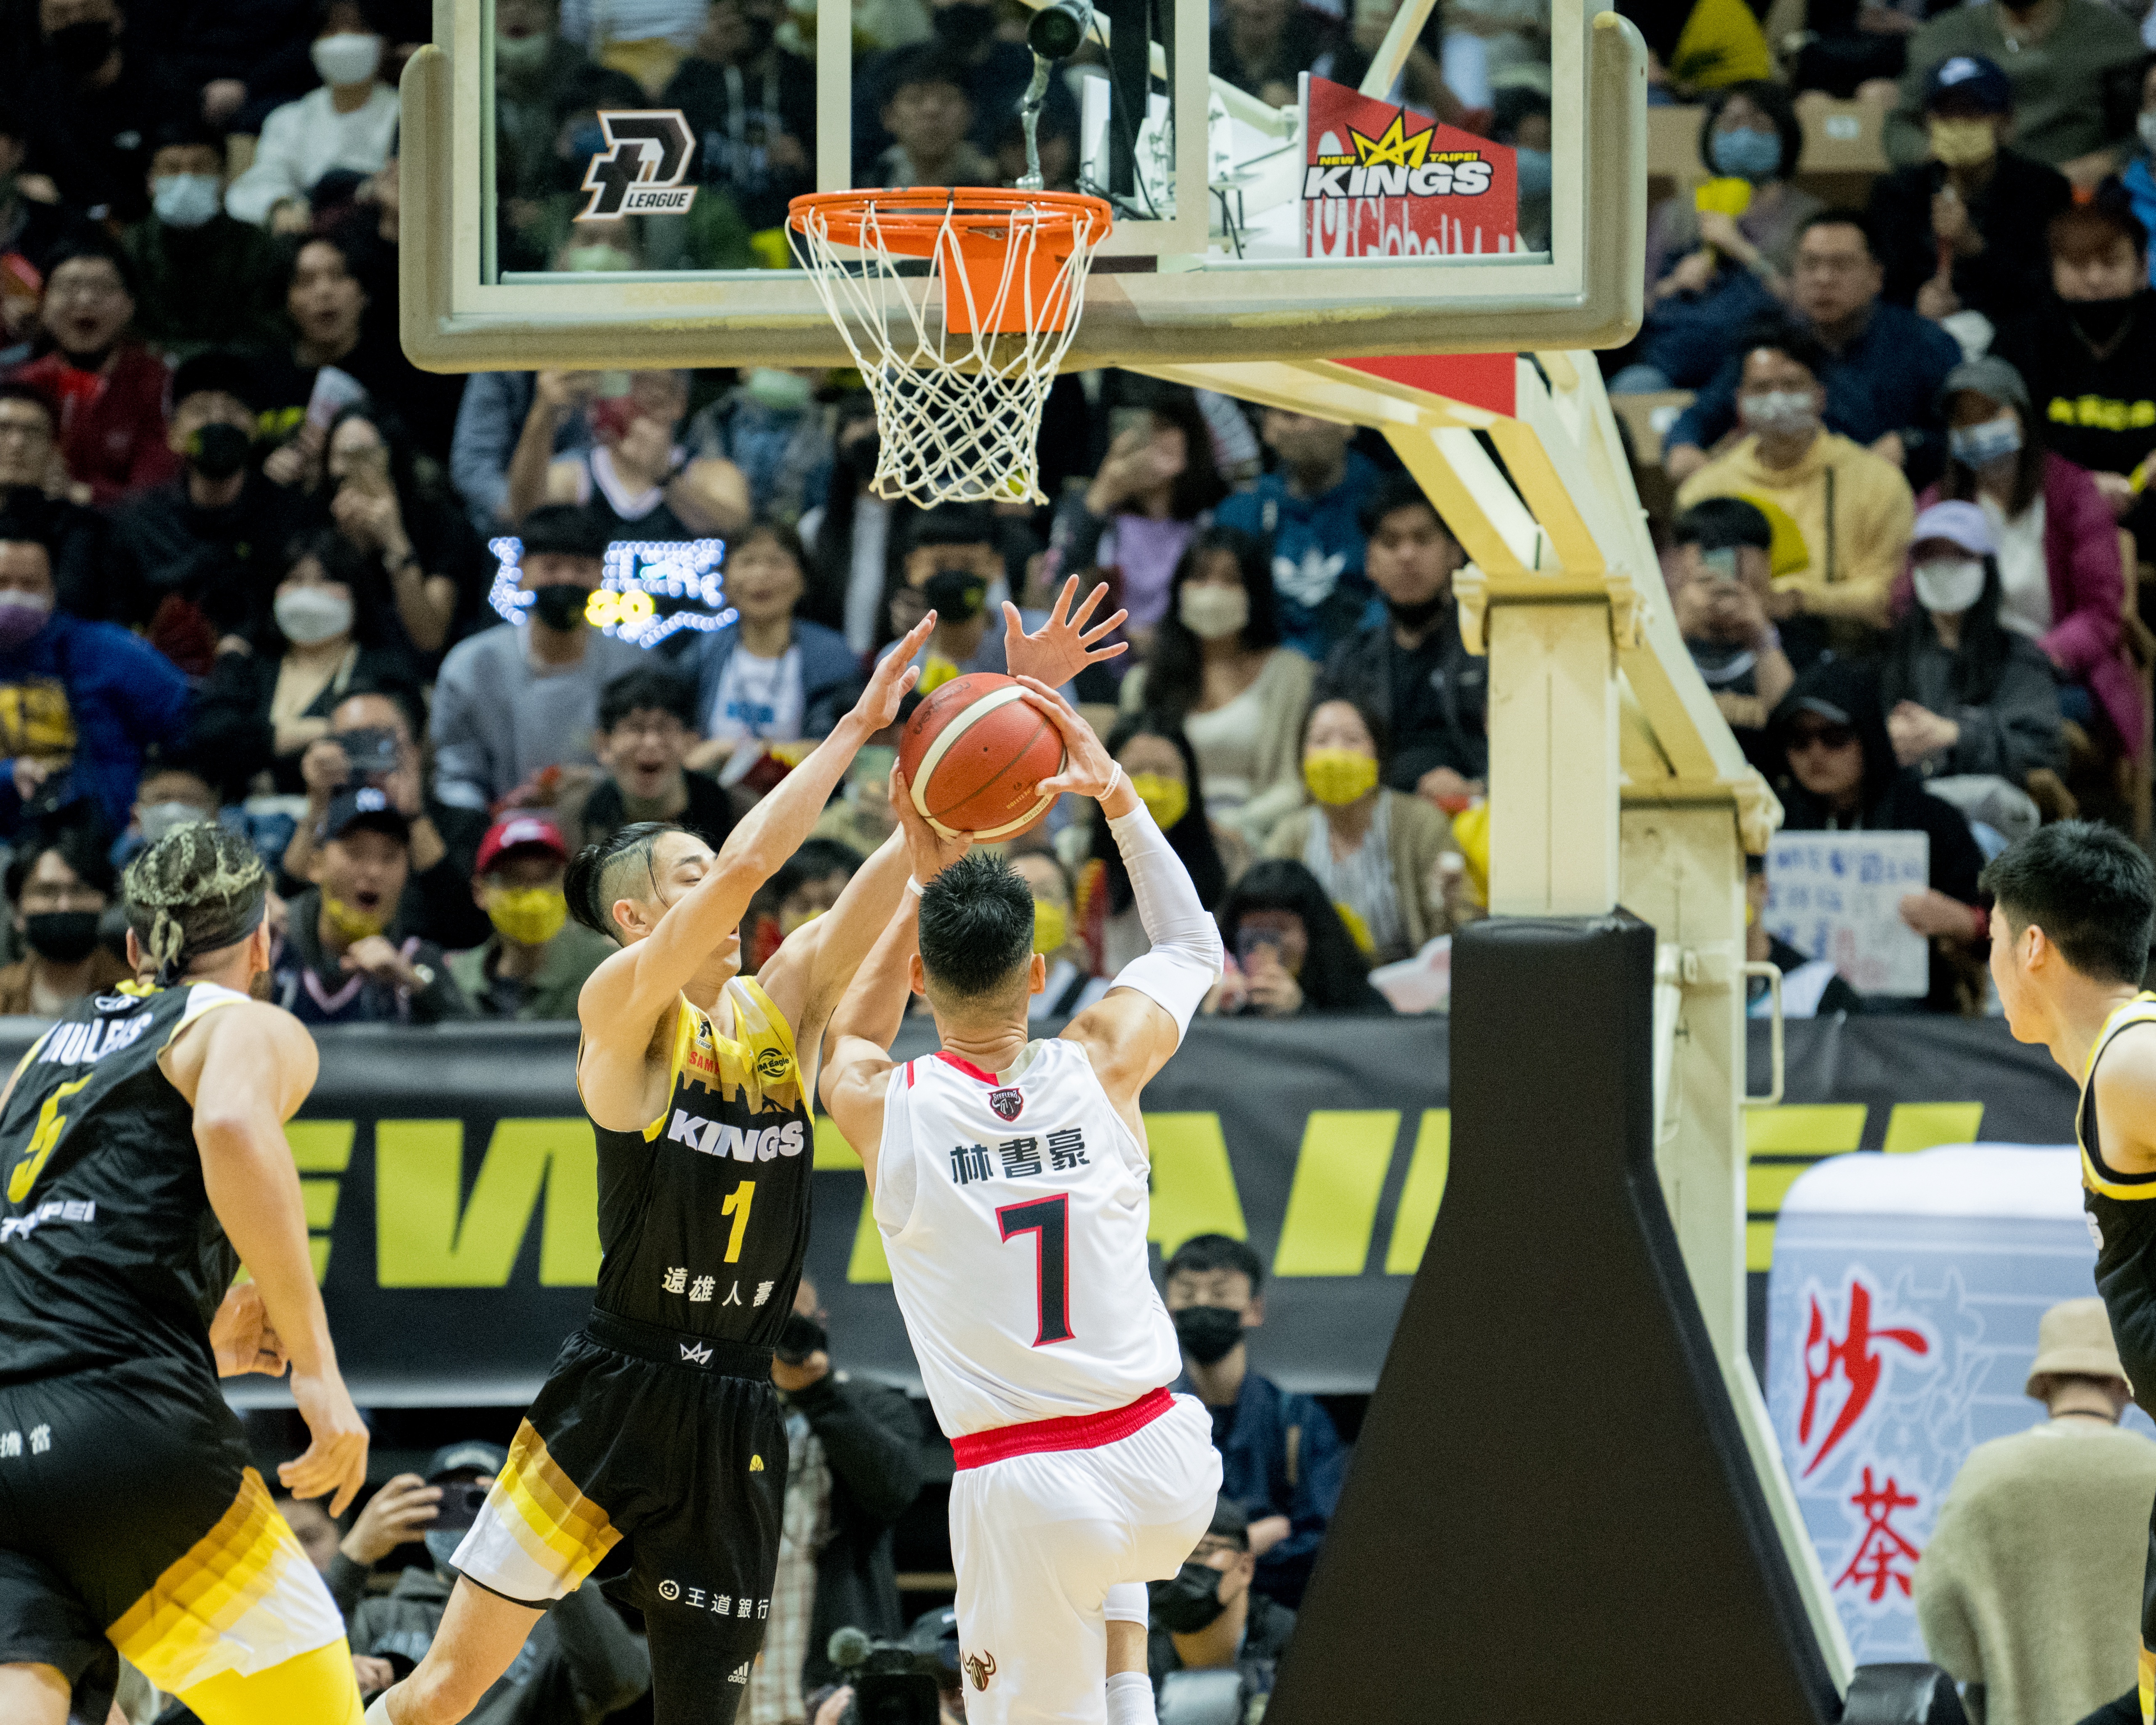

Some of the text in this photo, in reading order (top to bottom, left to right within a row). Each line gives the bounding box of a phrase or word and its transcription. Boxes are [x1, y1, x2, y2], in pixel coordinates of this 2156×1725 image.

[1319, 152, 1478, 165] NEW TAIPEI
[1304, 161, 1492, 197] KINGS
[626, 193, 688, 208] LEAGUE
[696, 1038, 712, 1050] LEAGUE
[768, 1057, 790, 1068] Eagle
[7, 1073, 93, 1204] 5
[667, 1108, 804, 1163] KINGS
[949, 1128, 1090, 1185] 林書豪
[721, 1181, 756, 1263] 1
[661, 1266, 775, 1307] 遠雄人壽
[995, 1192, 1076, 1347] 7
[1799, 1279, 1929, 1602] 沙茶
[685, 1587, 769, 1619] 王道銀行
[728, 1674, 747, 1685] adidas
